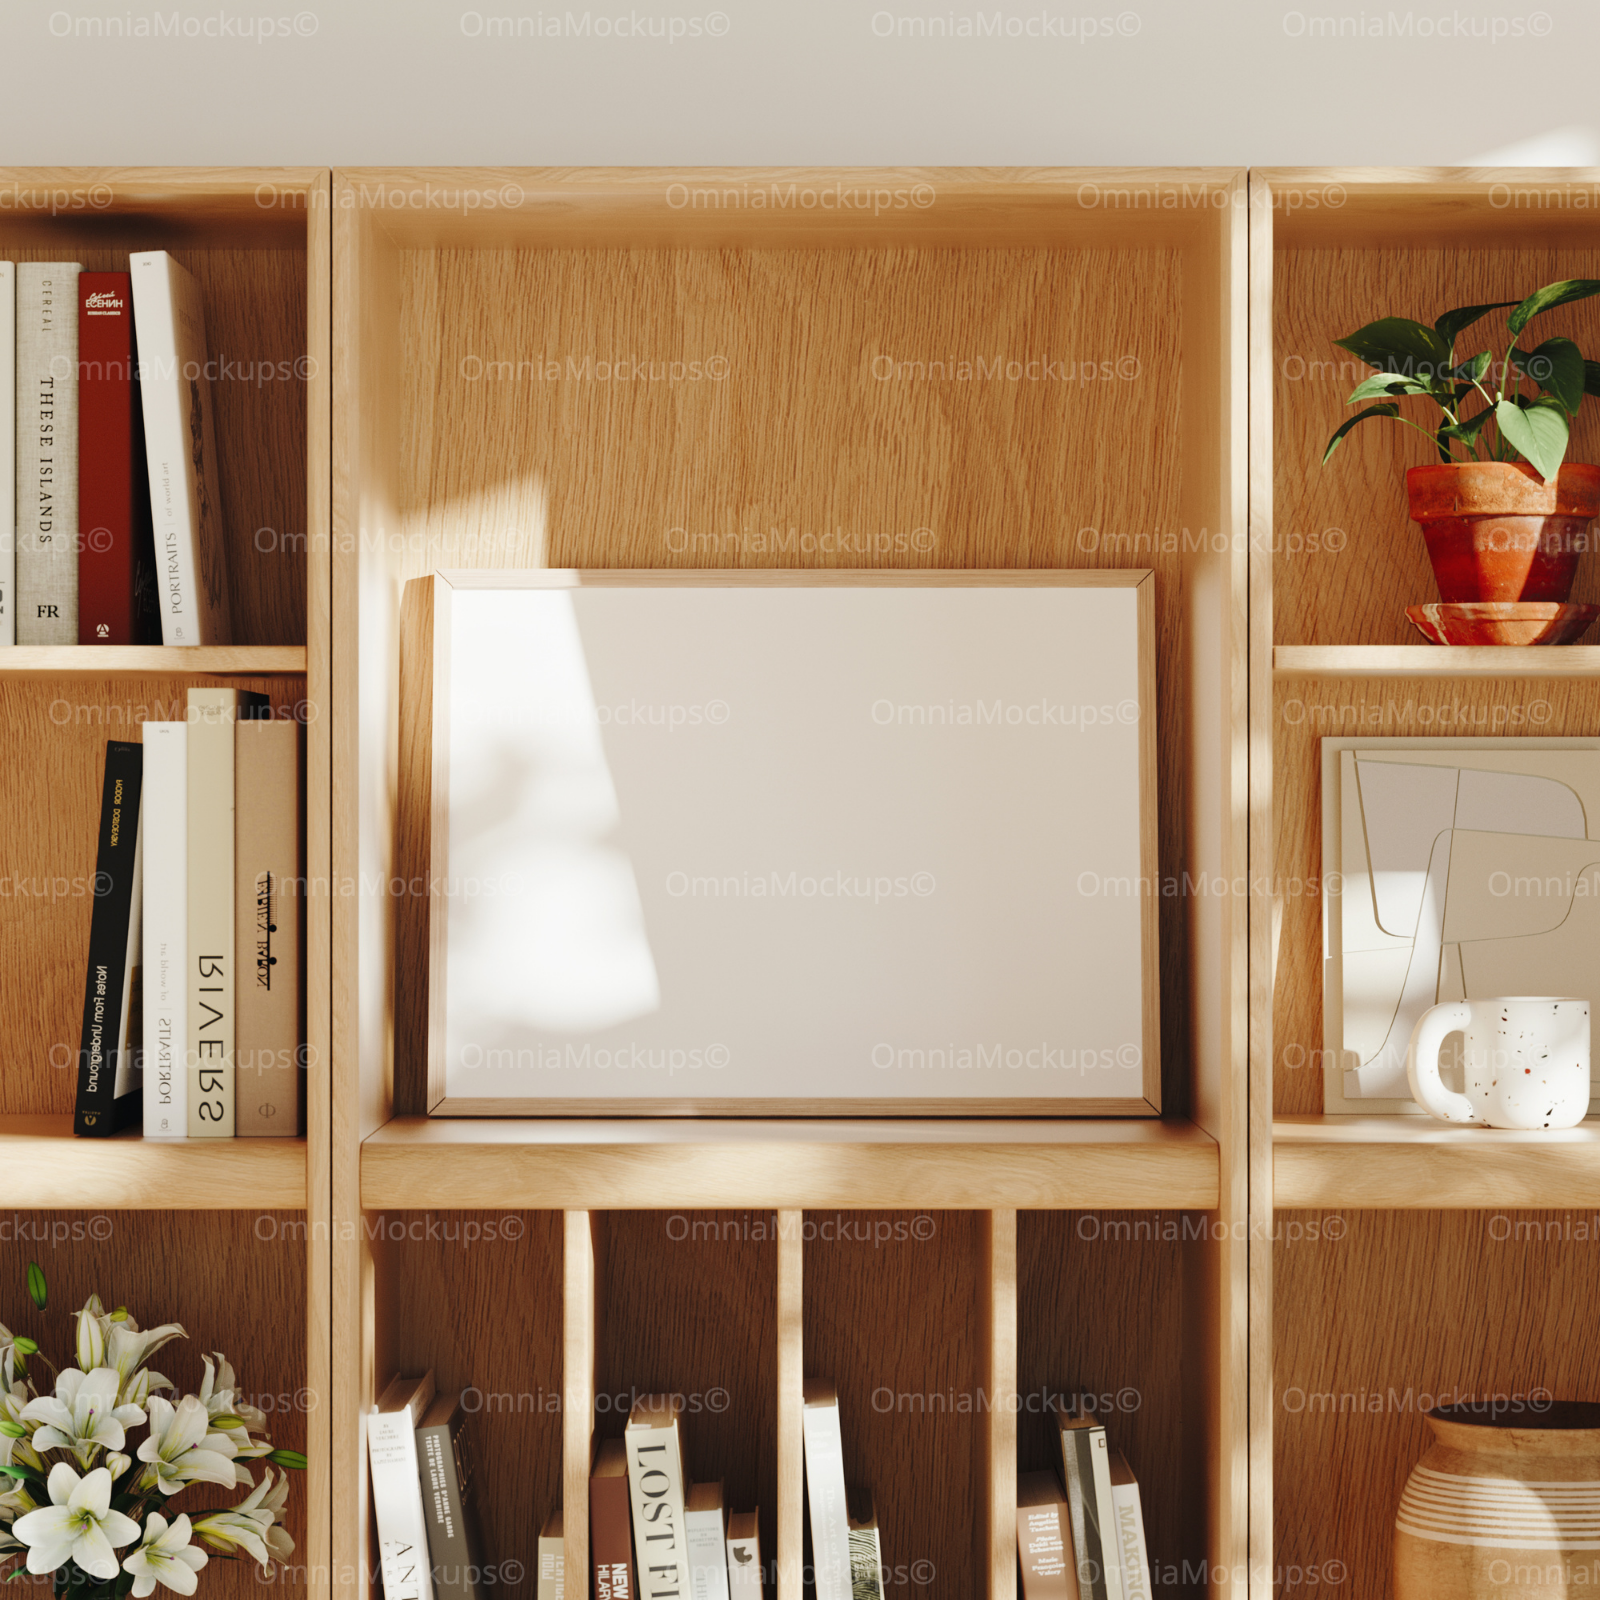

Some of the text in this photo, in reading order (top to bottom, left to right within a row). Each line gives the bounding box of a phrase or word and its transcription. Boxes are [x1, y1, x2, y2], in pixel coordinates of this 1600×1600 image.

[42, 280, 52, 332] CEREAL
[86, 299, 123, 308] ЕСЕНИН
[39, 376, 54, 544] THESE ISLANDS
[165, 532, 183, 615] PORTRAITS
[37, 605, 59, 618] FR
[636, 1441, 675, 1550] LOST
[611, 1562, 629, 1599] NEW
